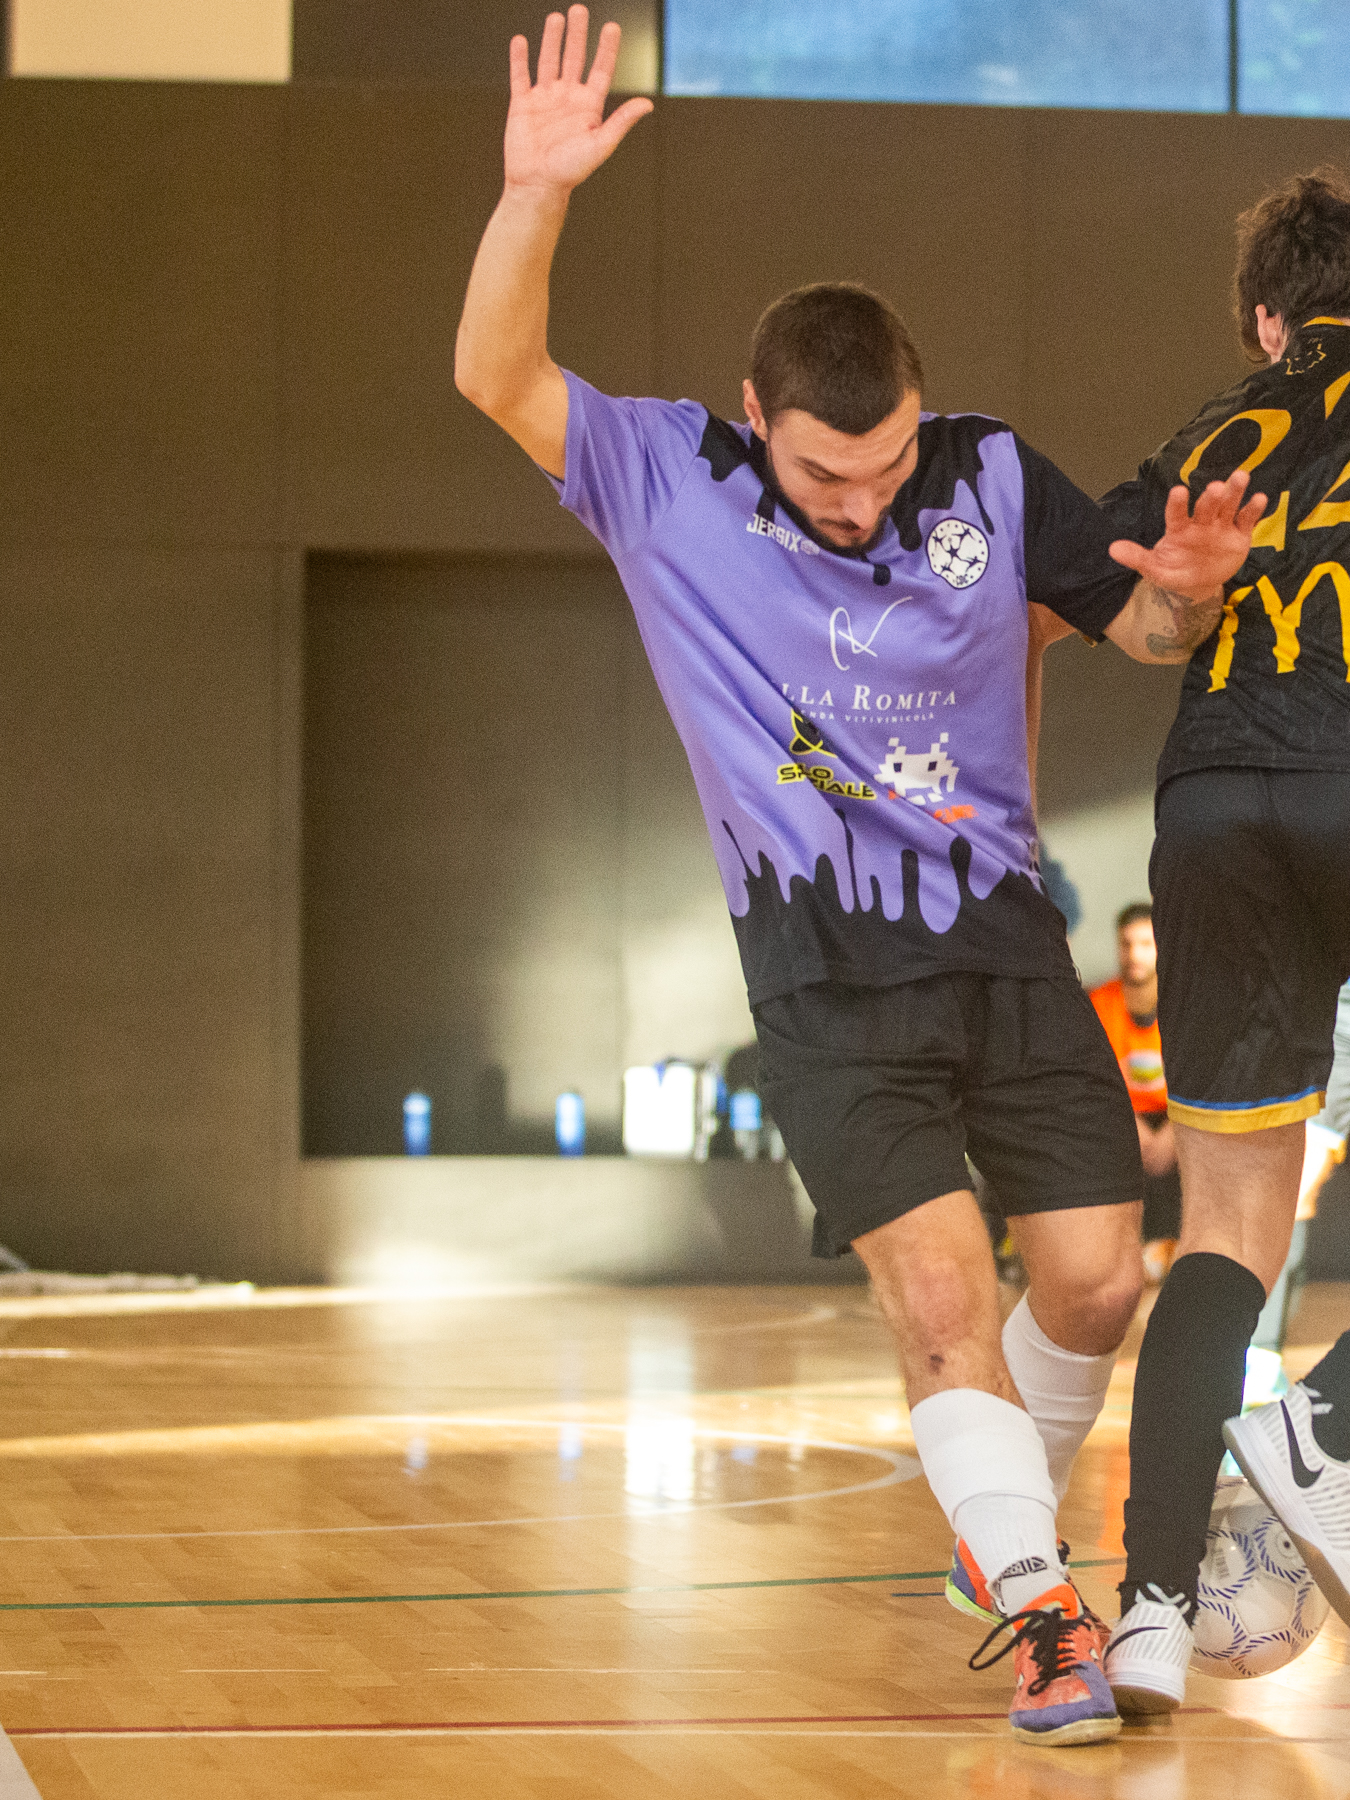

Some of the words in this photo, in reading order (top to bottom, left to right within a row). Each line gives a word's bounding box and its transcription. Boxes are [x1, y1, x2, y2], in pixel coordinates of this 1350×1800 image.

[746, 513, 801, 554] JERSIX
[782, 683, 834, 707] LLA
[853, 684, 956, 711] ROMITA
